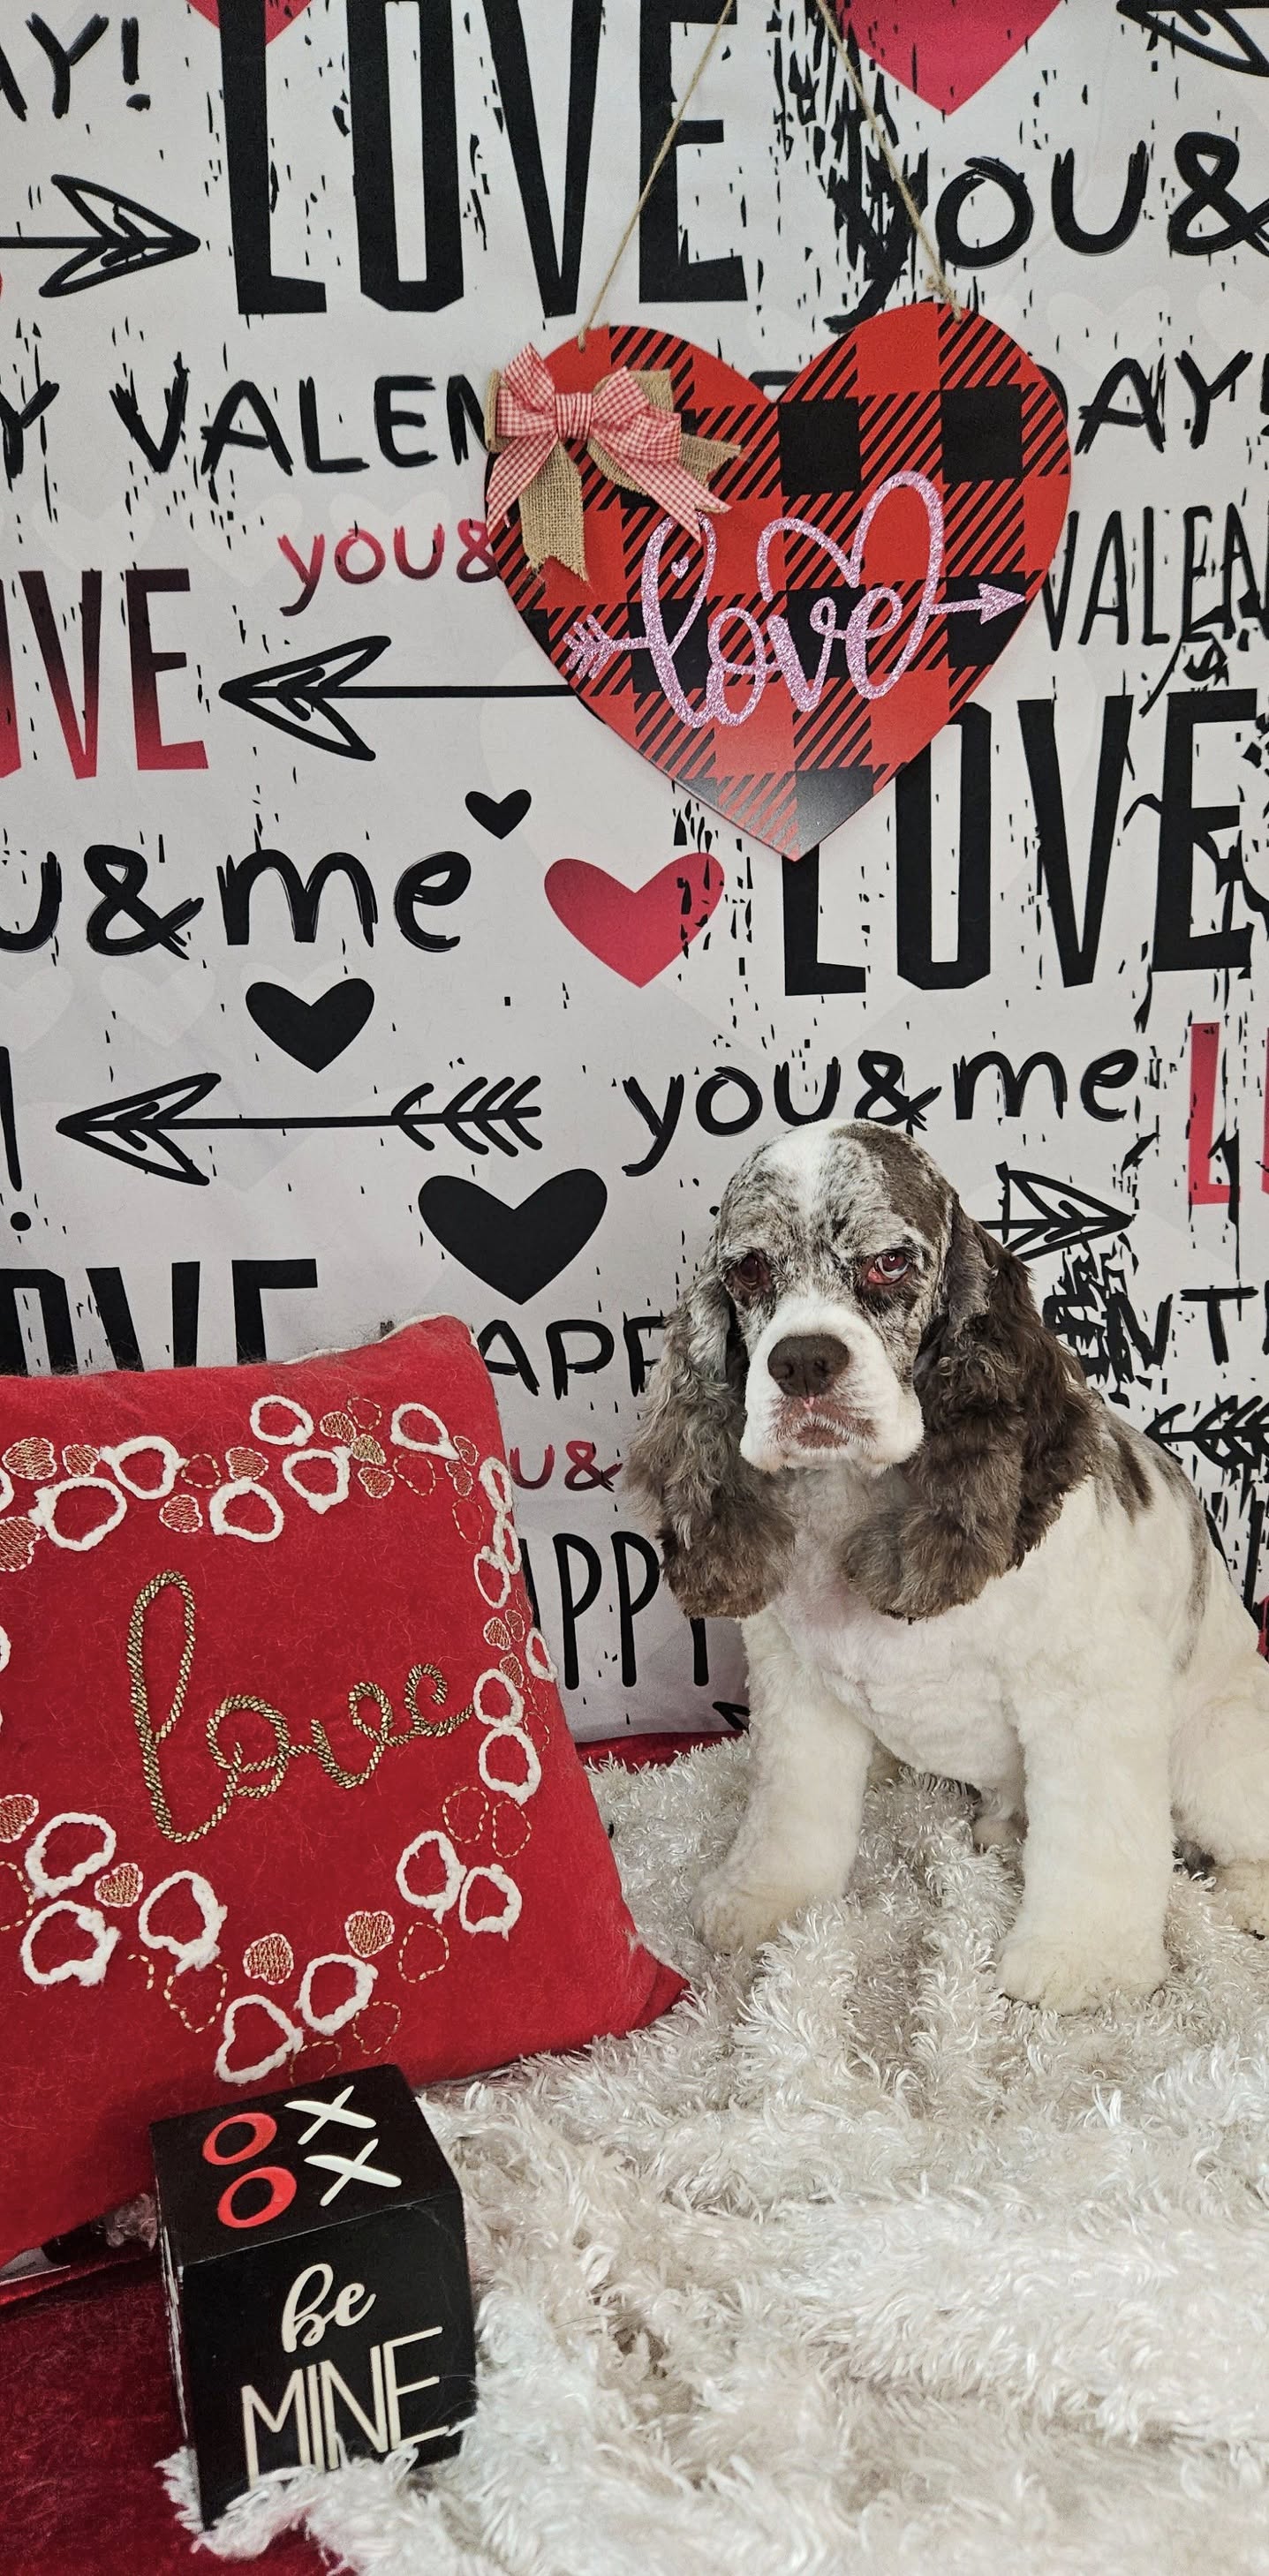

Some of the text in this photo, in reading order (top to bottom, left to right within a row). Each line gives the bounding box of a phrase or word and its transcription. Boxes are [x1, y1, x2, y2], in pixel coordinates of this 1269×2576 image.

[218, 0, 748, 318] LOVE
[0, 569, 208, 780] VE
[642, 471, 945, 728] love
[622, 1048, 1139, 1177] you&me
[127, 1570, 475, 1844] love
[241, 2326, 449, 2492] MINE
[281, 2263, 376, 2354] be
